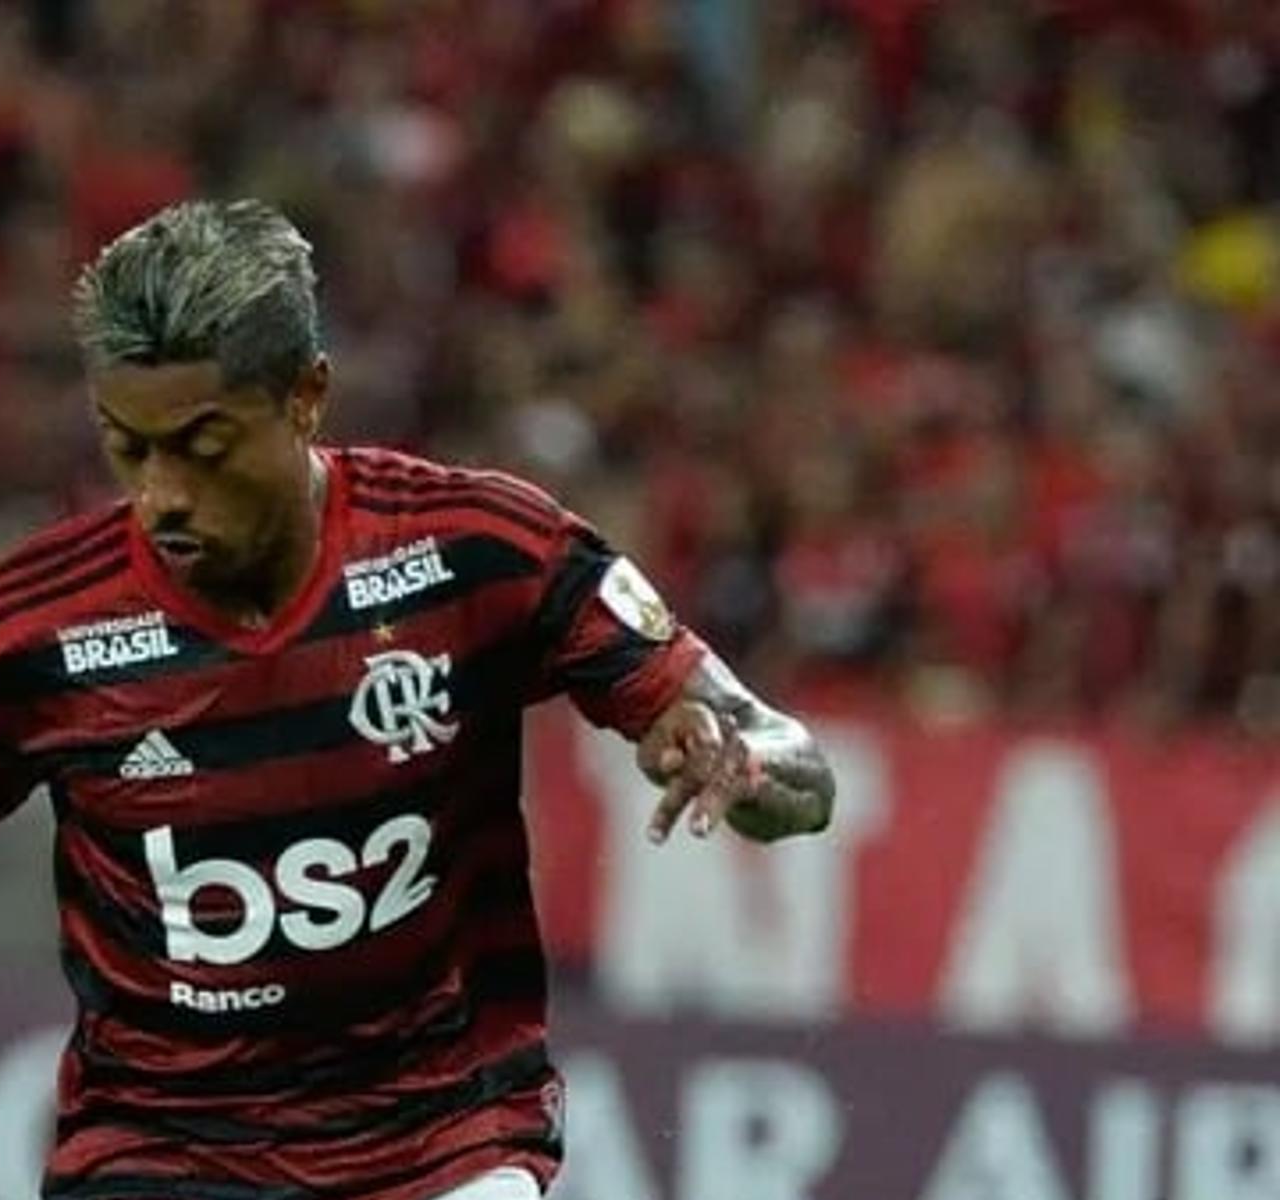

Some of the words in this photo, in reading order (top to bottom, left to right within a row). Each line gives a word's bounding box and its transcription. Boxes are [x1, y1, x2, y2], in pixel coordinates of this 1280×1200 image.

[347, 552, 456, 611] BRASIL
[62, 627, 179, 675] BRASIL
[142, 813, 439, 966] bs2
